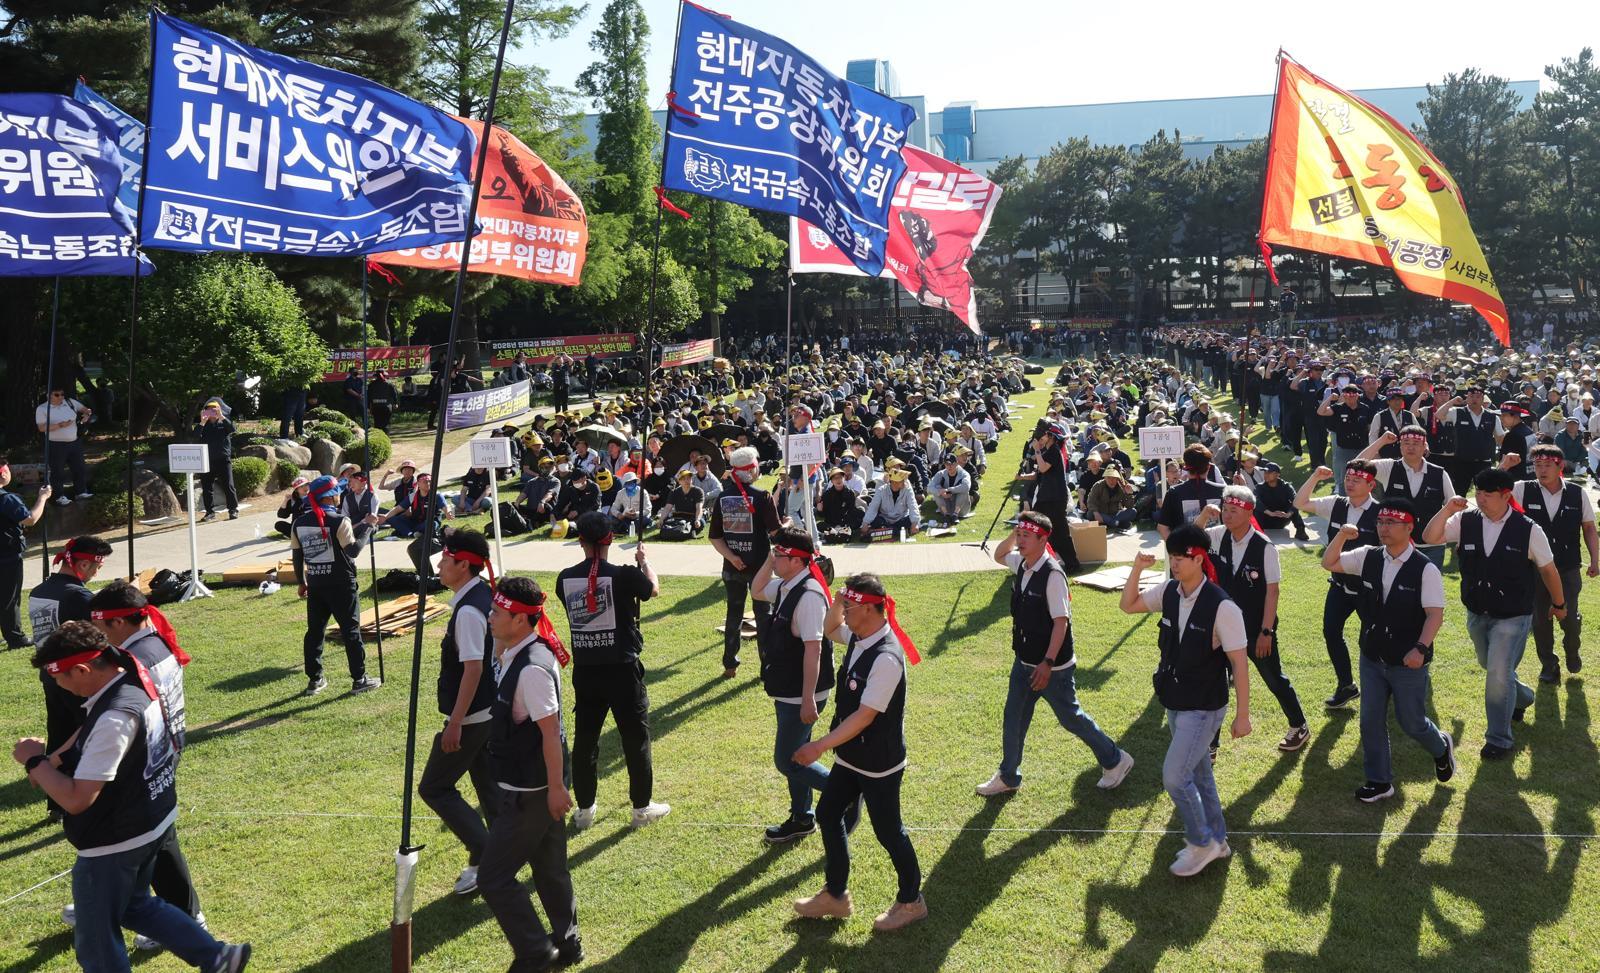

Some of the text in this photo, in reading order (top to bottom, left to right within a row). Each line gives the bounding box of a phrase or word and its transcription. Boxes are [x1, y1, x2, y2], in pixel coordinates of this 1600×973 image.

[172, 36, 462, 176] 현대자동차지부
[688, 78, 892, 208] 전주공장위원회
[696, 31, 904, 159] 현대자동차지부
[730, 163, 873, 261] 전국금속노동조합
[1315, 190, 1355, 222] 선봉
